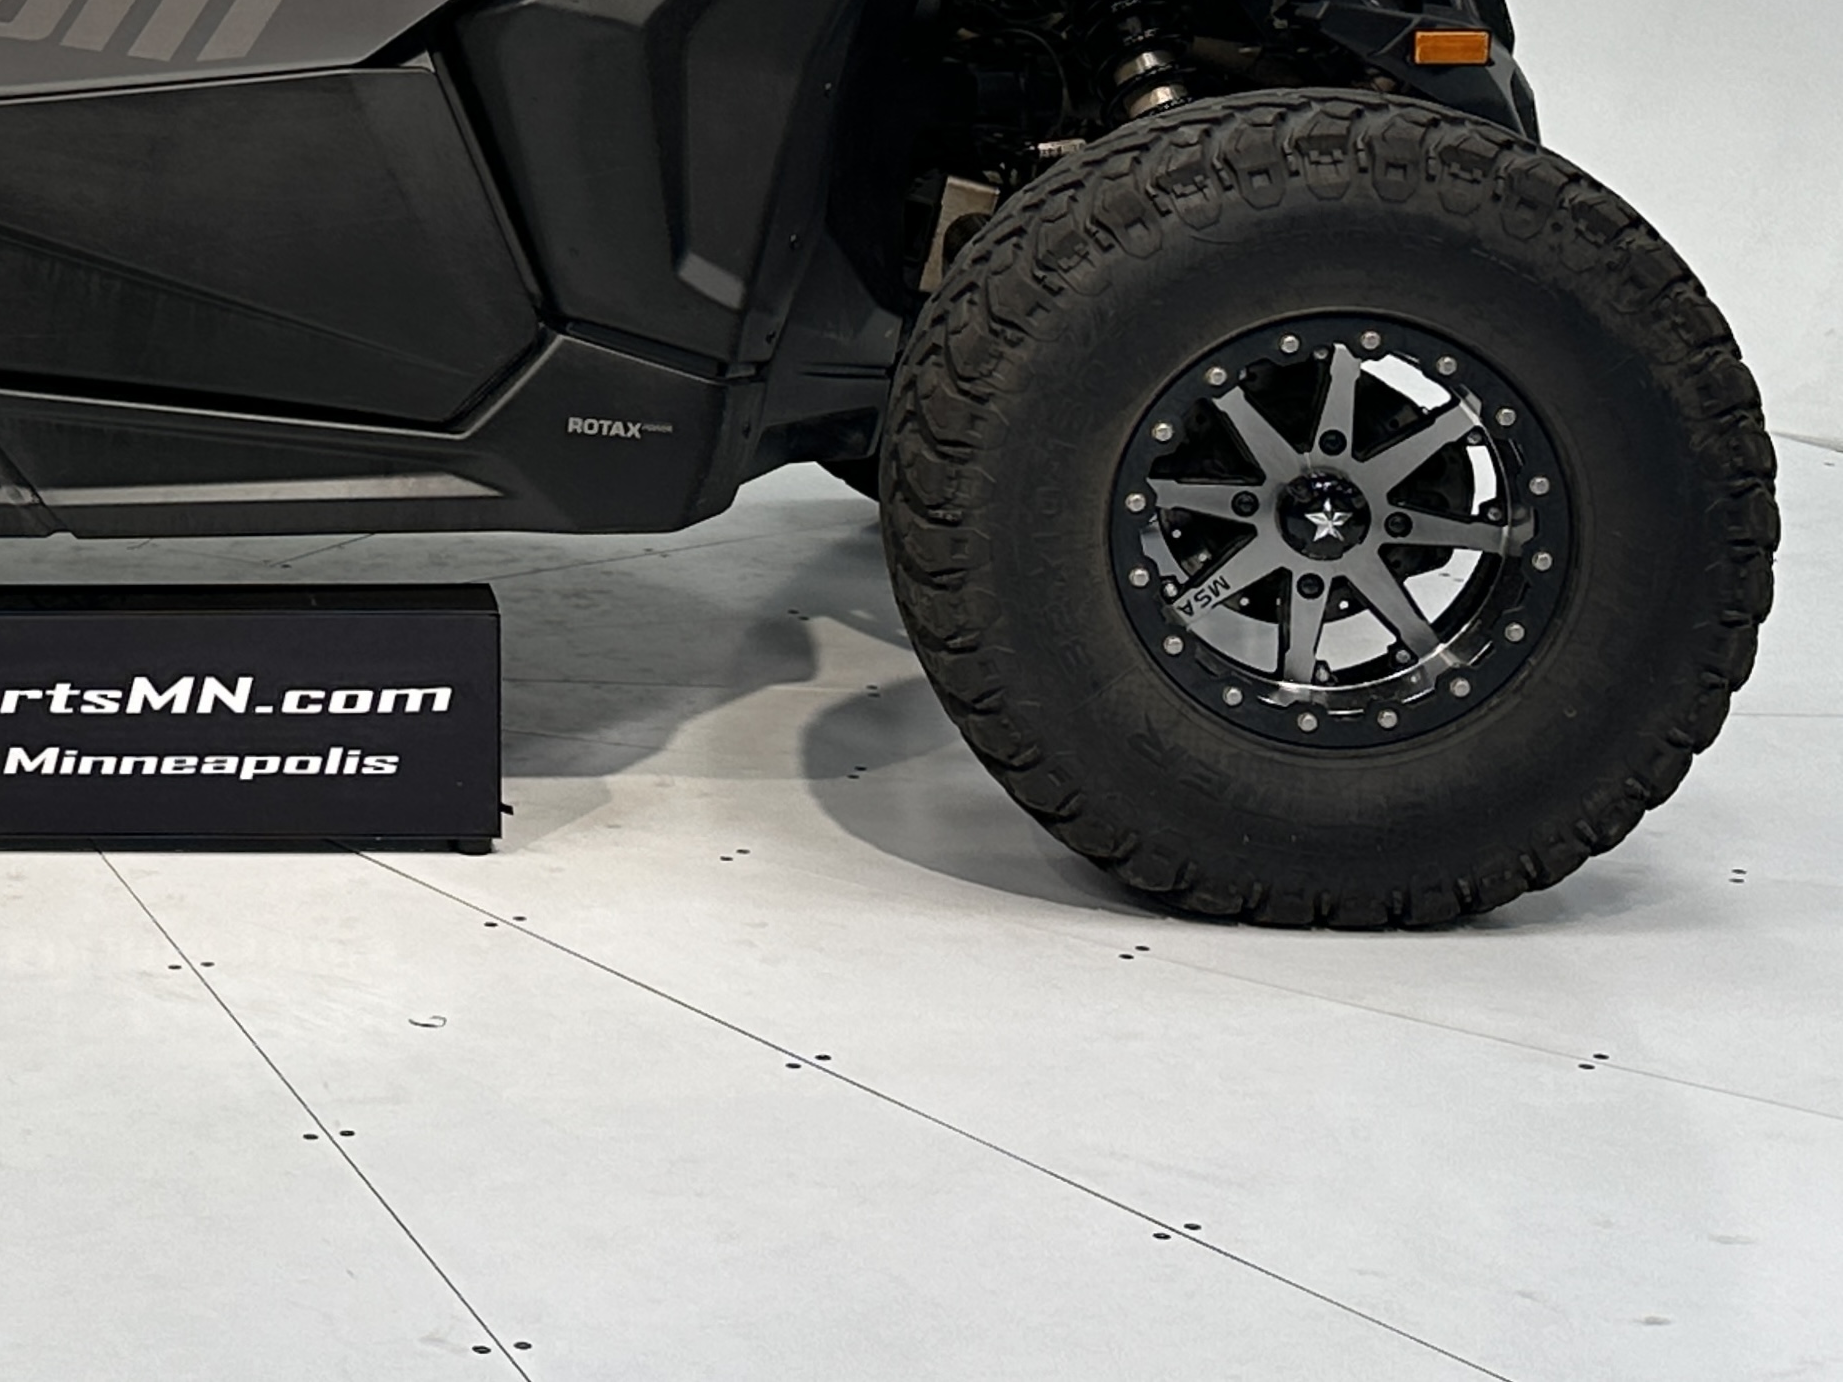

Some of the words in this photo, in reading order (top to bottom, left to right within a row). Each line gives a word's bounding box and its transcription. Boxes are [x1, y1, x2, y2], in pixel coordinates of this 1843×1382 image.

[567, 417, 642, 439] ROTAX
[1176, 575, 1231, 617] MSA
[4, 747, 399, 780] Minneapolis
